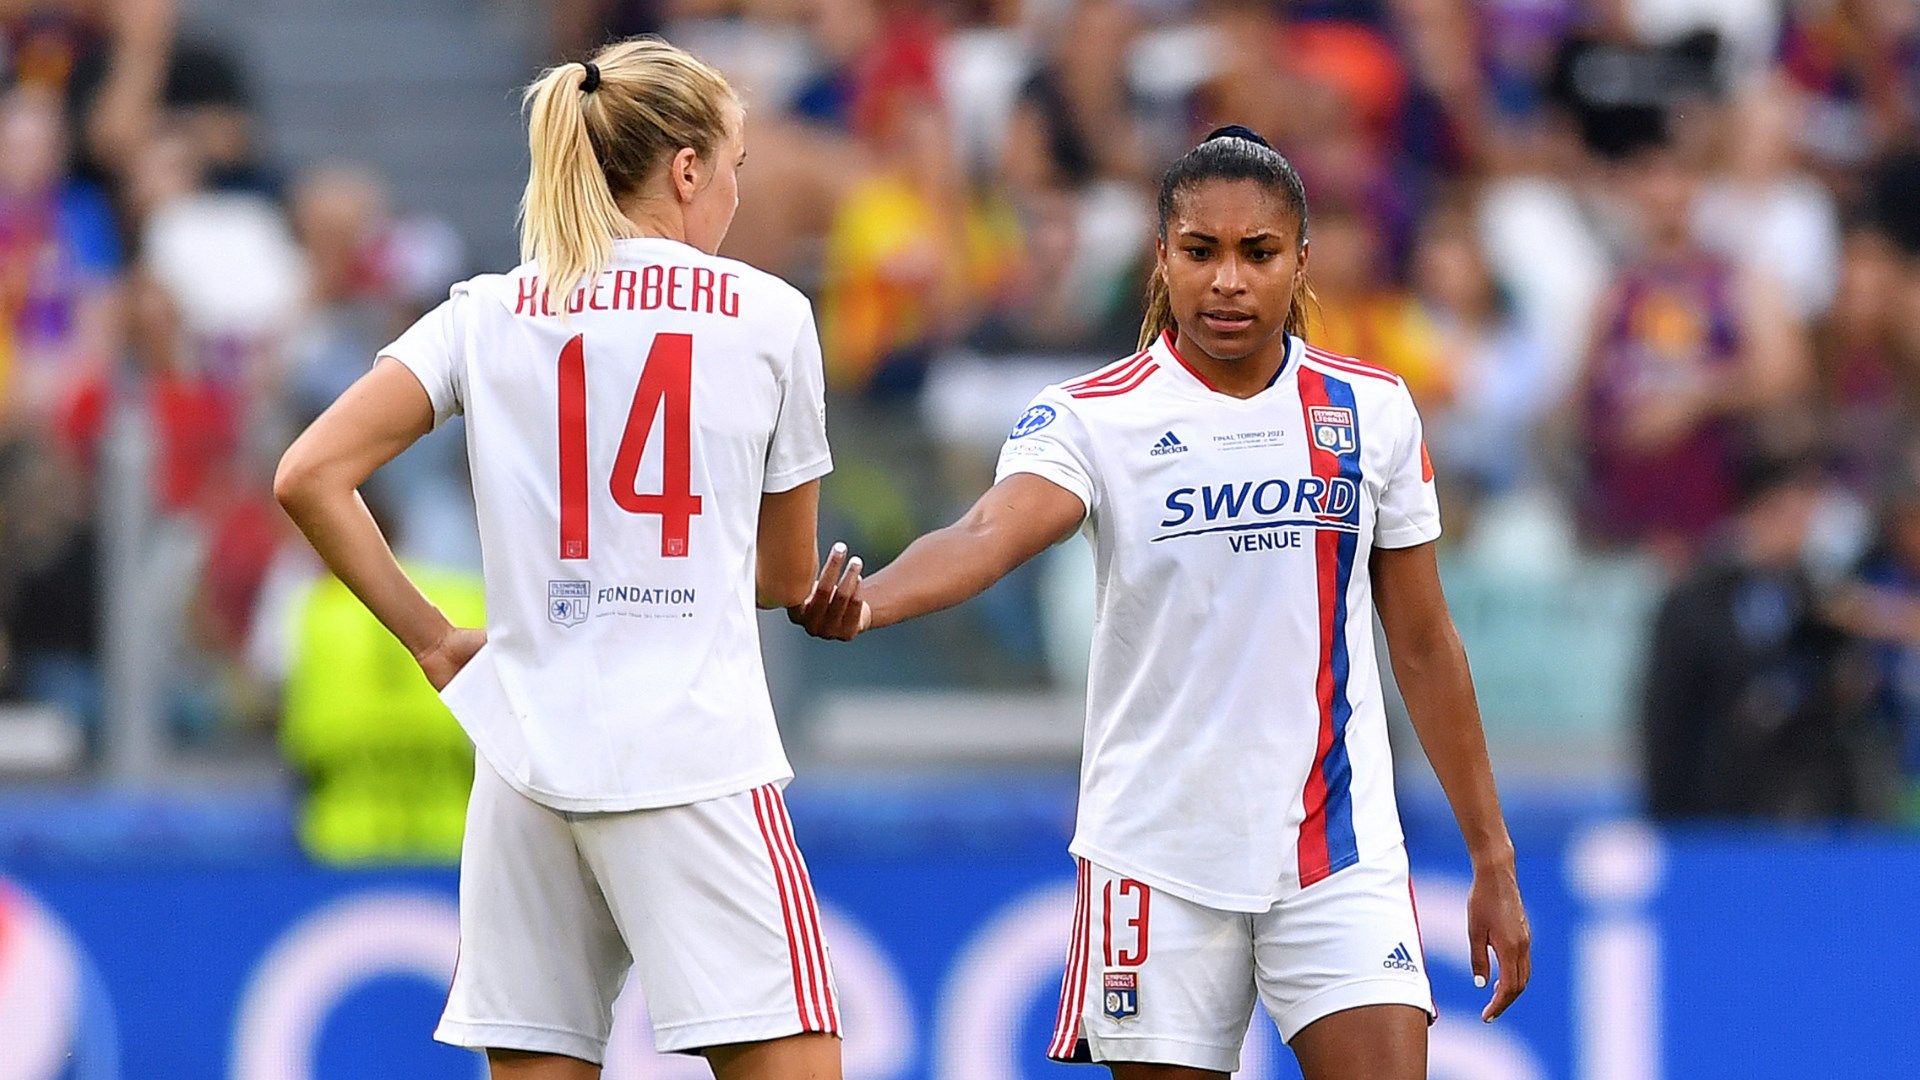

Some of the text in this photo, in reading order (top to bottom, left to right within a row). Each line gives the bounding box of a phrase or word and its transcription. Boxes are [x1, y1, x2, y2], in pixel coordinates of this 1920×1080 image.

[515, 264, 739, 318] HERBERG
[558, 333, 702, 560] 14
[1150, 445, 1188, 456] adidas
[1161, 478, 1355, 527] SWORD
[1229, 531, 1301, 553] VENUE
[597, 586, 695, 605] FONDATION
[1103, 878, 1150, 967] 13
